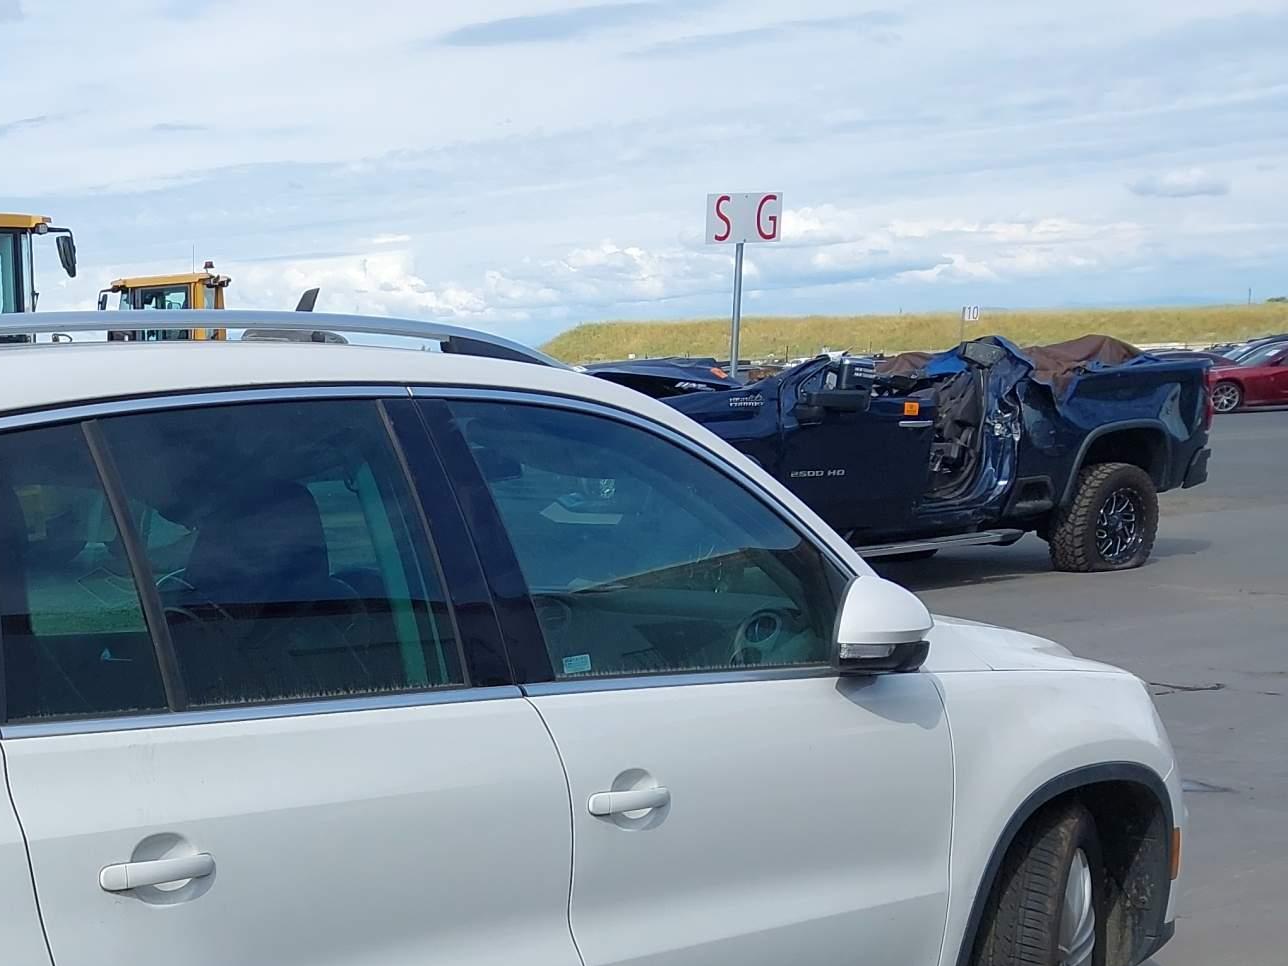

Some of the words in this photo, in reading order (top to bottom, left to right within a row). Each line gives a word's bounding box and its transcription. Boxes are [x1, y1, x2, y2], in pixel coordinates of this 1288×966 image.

[715, 195, 731, 242] S
[757, 194, 778, 241] G
[967, 306, 979, 320] 10
[791, 470, 824, 478] 2500
